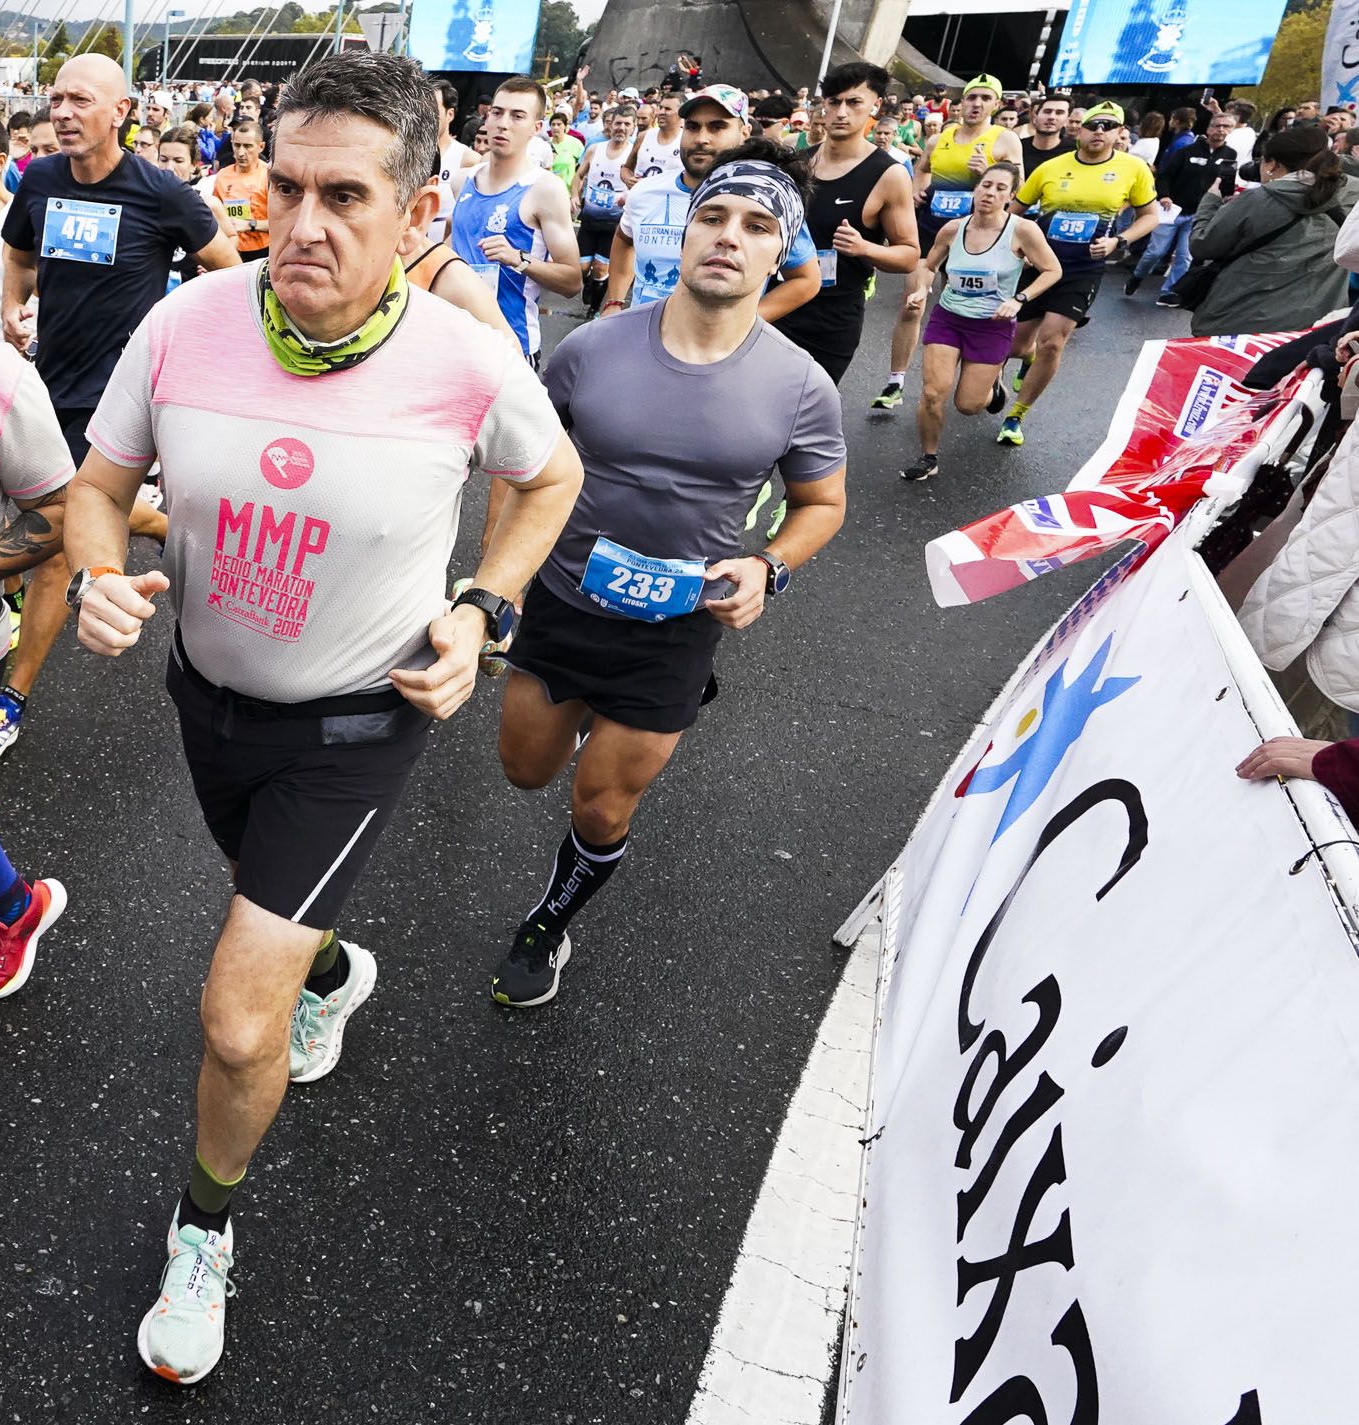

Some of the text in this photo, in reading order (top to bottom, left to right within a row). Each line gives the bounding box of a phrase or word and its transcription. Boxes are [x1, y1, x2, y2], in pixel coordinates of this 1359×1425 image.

[227, 205, 243, 217] 108
[940, 198, 961, 209] 312
[61, 215, 99, 243] 475
[1059, 221, 1085, 233] 315
[959, 277, 984, 289] 745
[216, 497, 332, 577] MMP
[213, 550, 316, 599] MEDIO MARATON
[607, 566, 676, 603] 233
[210, 568, 310, 622] PONTEVEDRA
[225, 600, 304, 639] CaixaBank 2016
[547, 853, 595, 916] Kalenji
